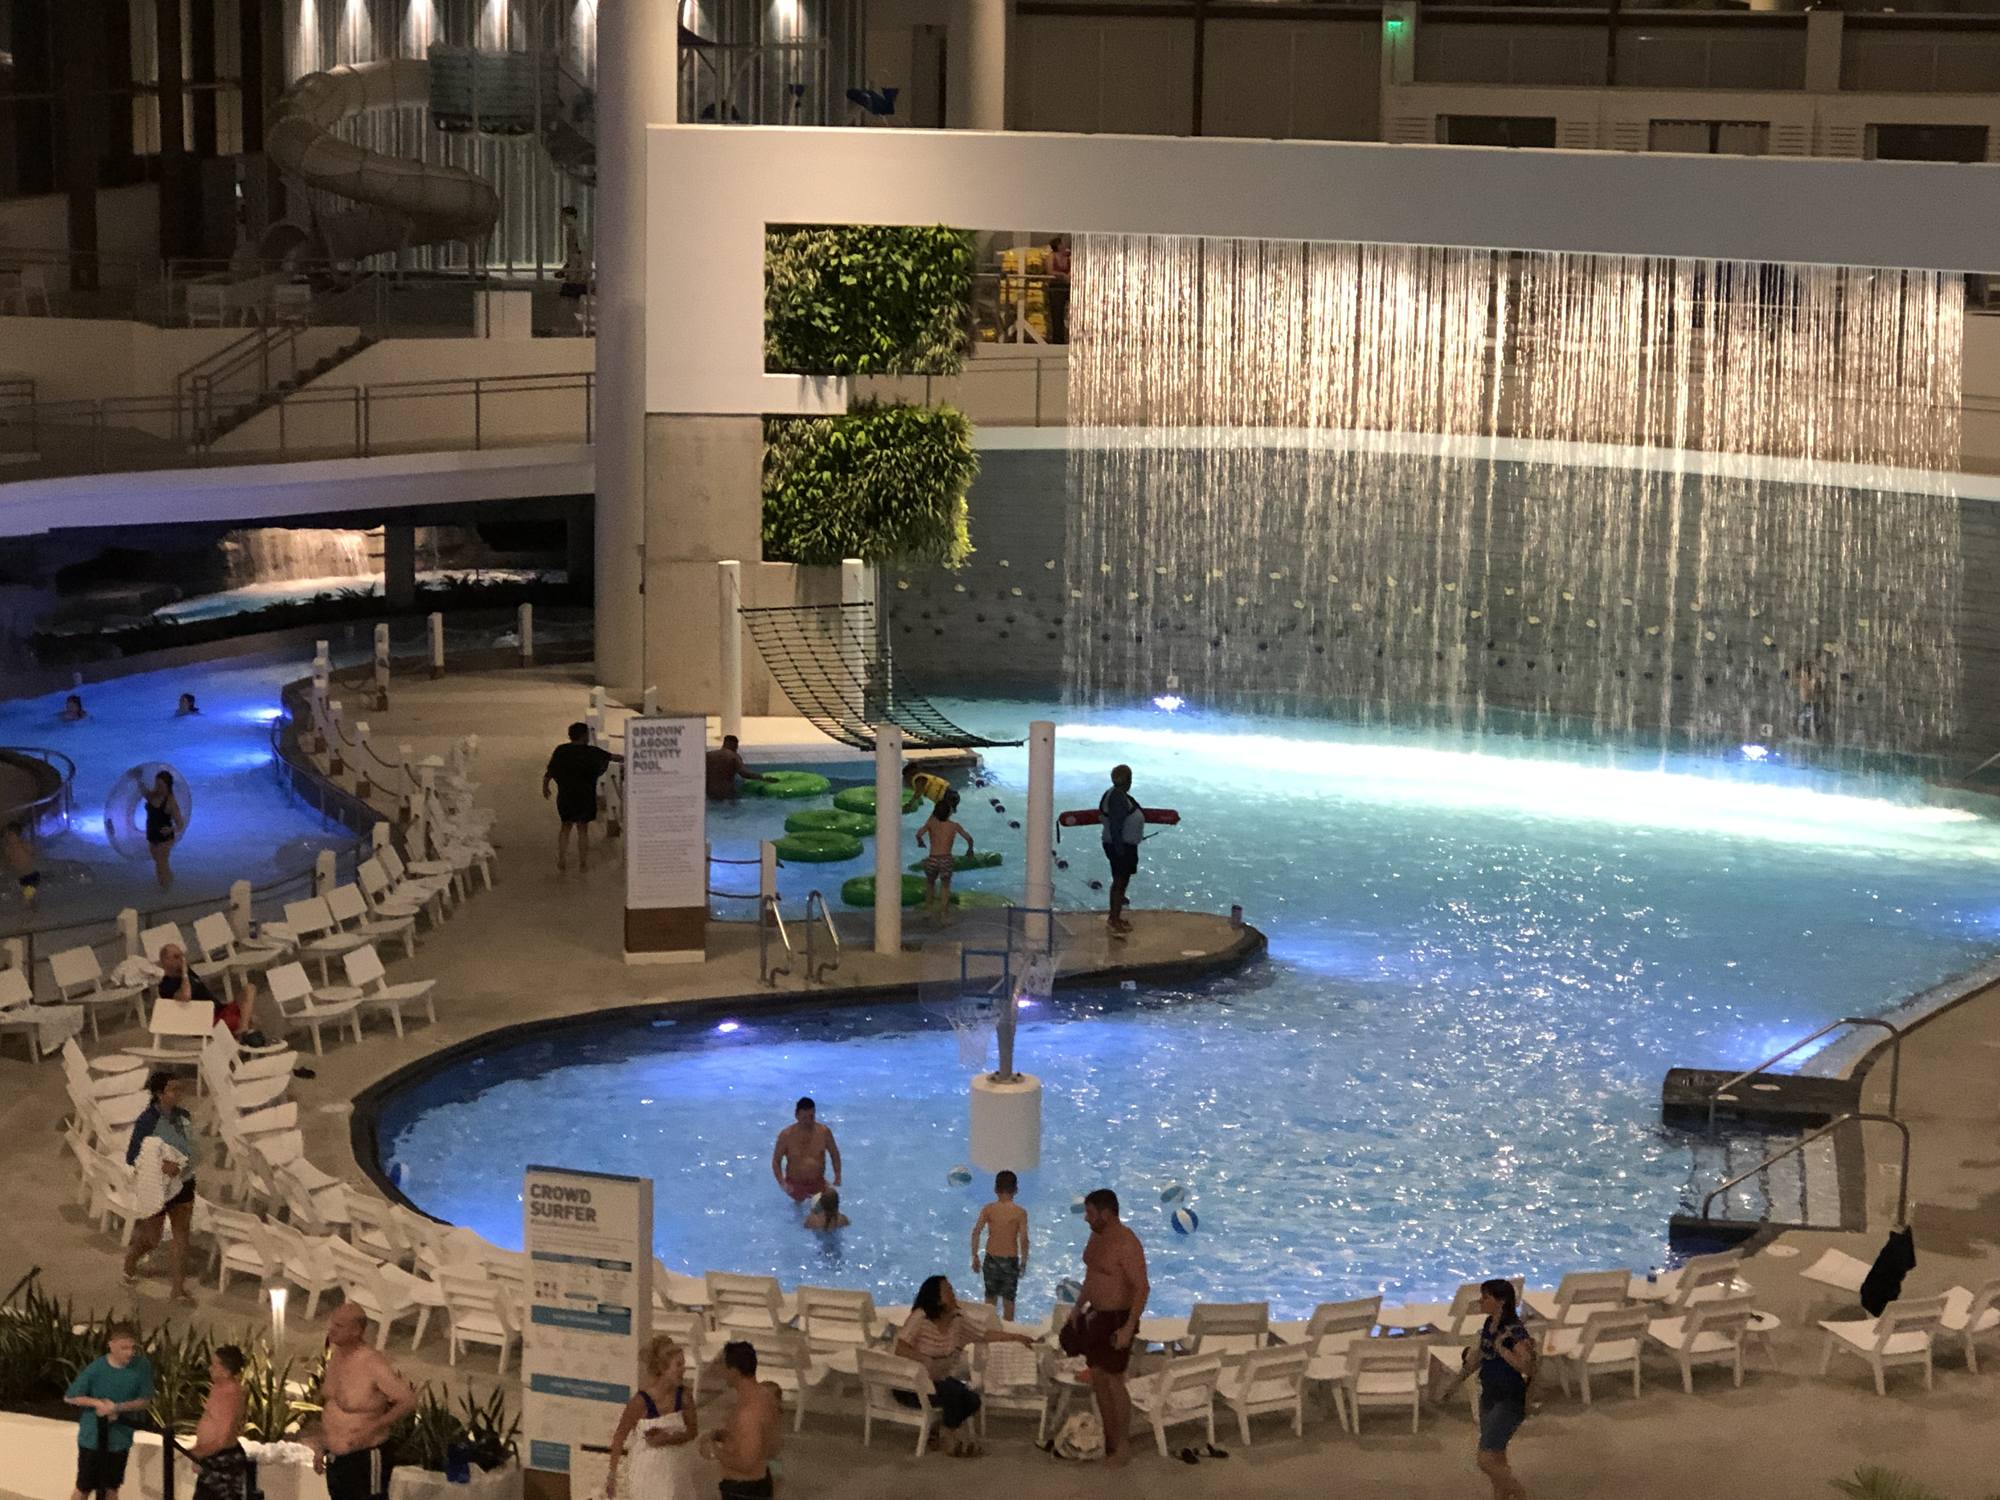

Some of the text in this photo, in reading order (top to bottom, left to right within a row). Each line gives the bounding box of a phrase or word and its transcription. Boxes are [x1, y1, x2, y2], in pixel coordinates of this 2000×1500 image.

[632, 737, 678, 748] LAGOON
[632, 749, 682, 759] ACTIVITY
[632, 760, 662, 771] POOL
[530, 1183, 592, 1204] CROWD
[530, 1201, 597, 1223] SURFER
